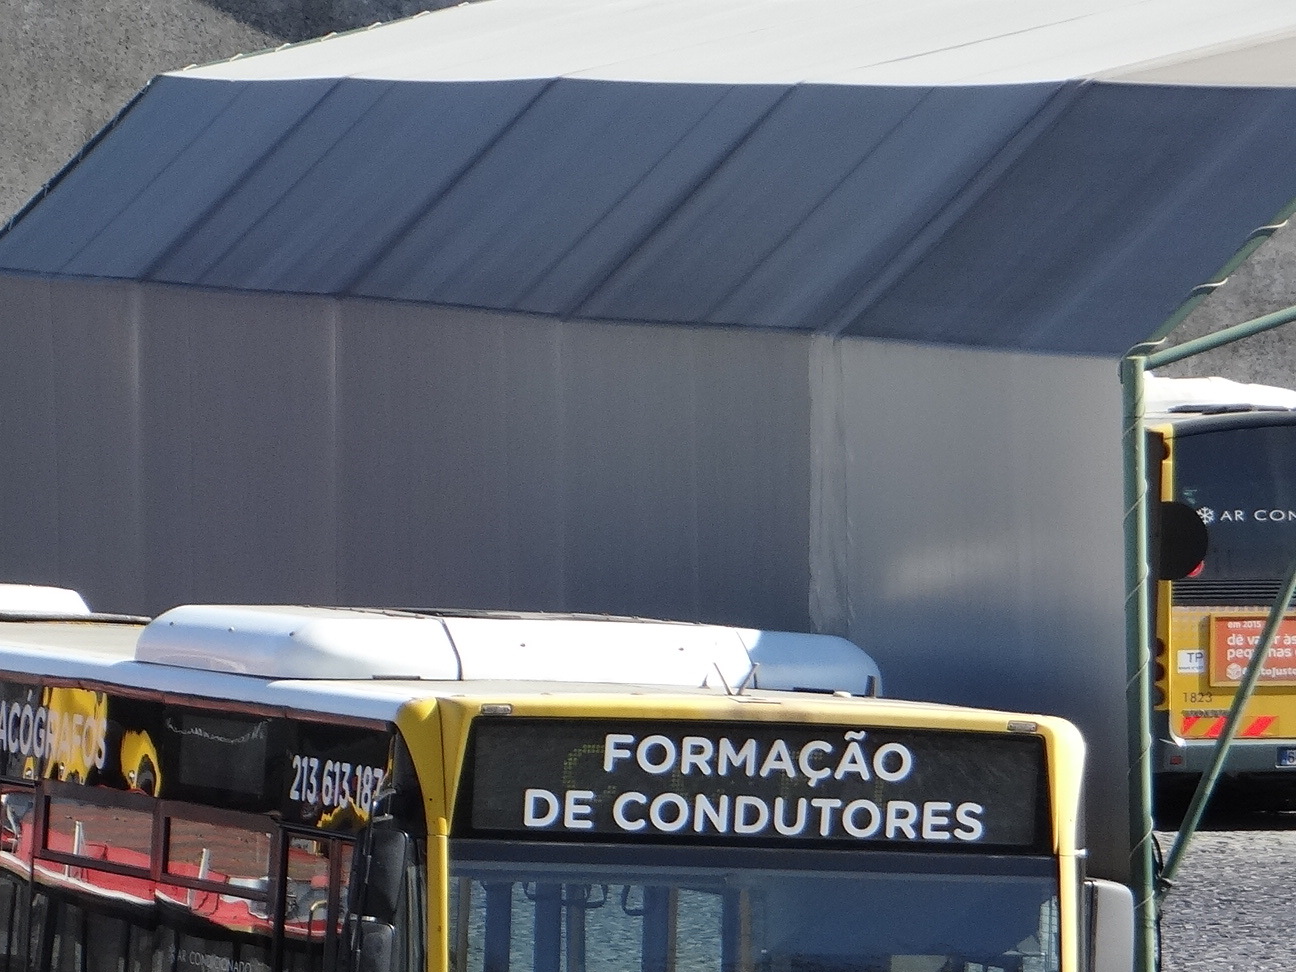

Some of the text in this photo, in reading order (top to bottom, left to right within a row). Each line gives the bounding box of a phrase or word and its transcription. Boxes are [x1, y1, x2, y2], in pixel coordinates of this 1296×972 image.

[1220, 509, 1244, 521] AR
[1242, 620, 1262, 628] 2015
[1187, 651, 1204, 663] TP
[1227, 648, 1292, 661] peqnas
[1183, 692, 1213, 703] 1823
[603, 730, 913, 787] FORMAÇÃO
[289, 754, 385, 815] 213 613 187
[522, 788, 985, 841] DE CONDUTORES
